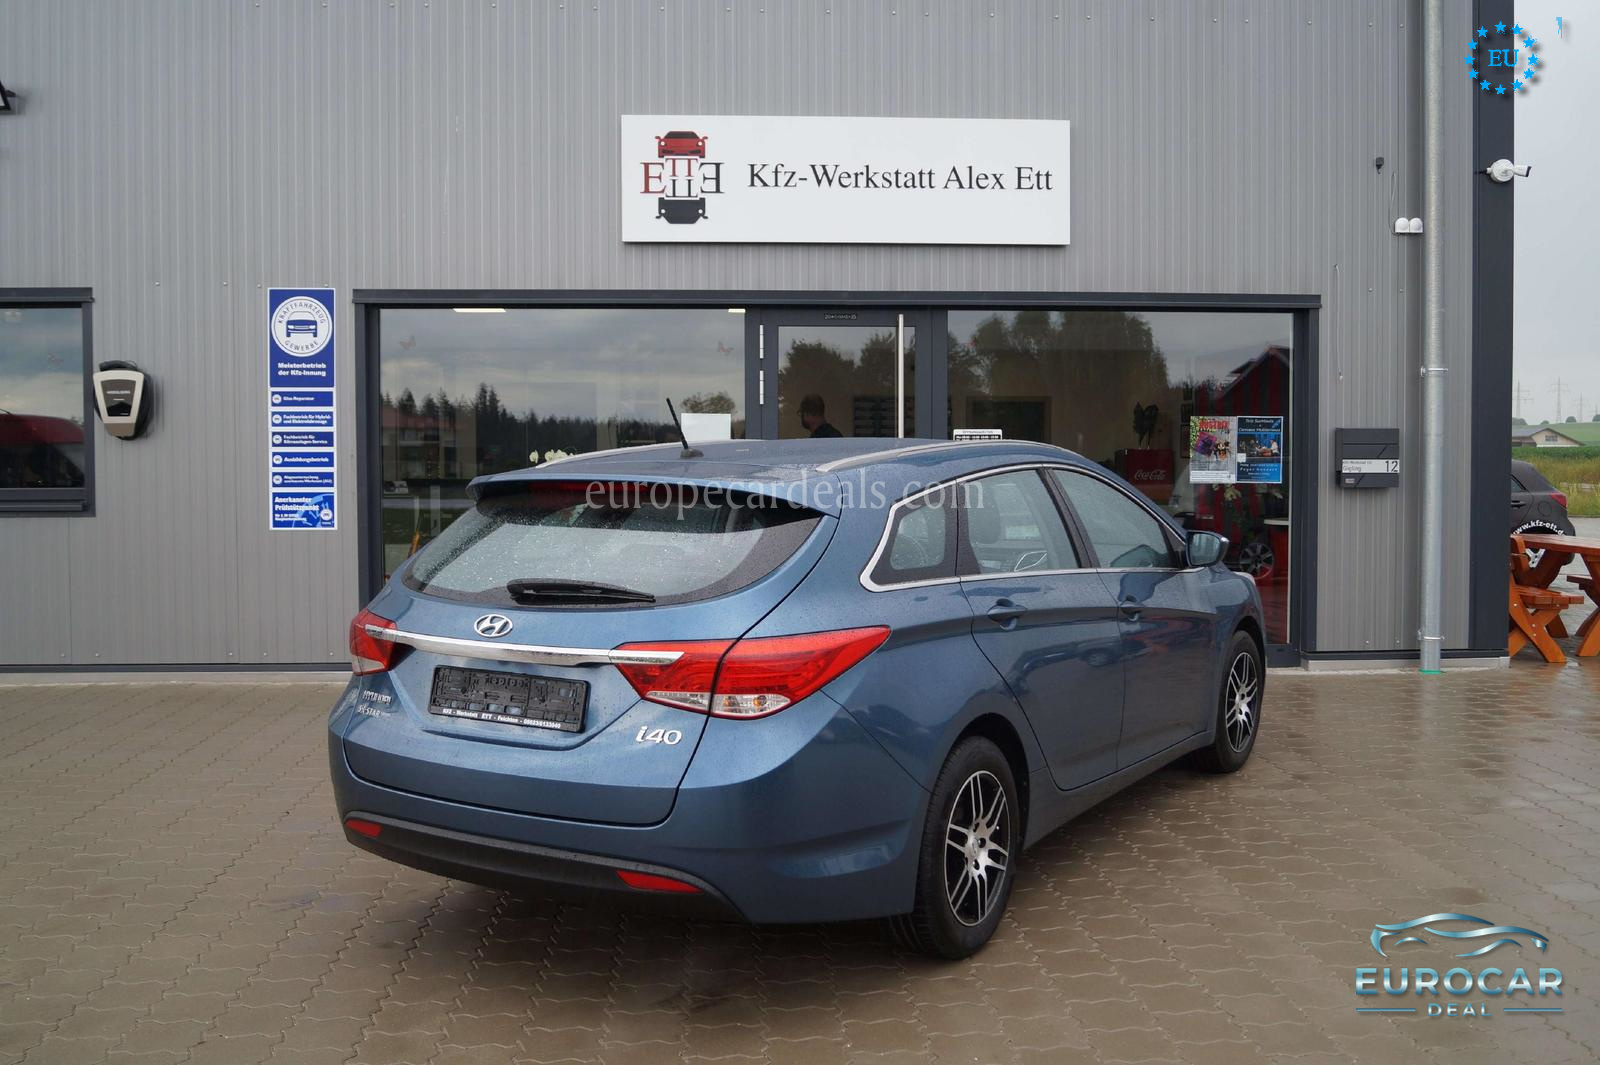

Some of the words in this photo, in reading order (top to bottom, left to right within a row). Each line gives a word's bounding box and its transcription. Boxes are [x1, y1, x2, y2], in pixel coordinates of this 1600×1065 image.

[748, 163, 936, 189] Kfz-Werkstatt
[943, 165, 1006, 190] Alex
[1015, 167, 1053, 191] Ett
[278, 302, 326, 324] KRAFTFAHRZEUG
[285, 340, 318, 352] GEWERBE
[1385, 460, 1399, 473] 12
[636, 725, 682, 745] i40
